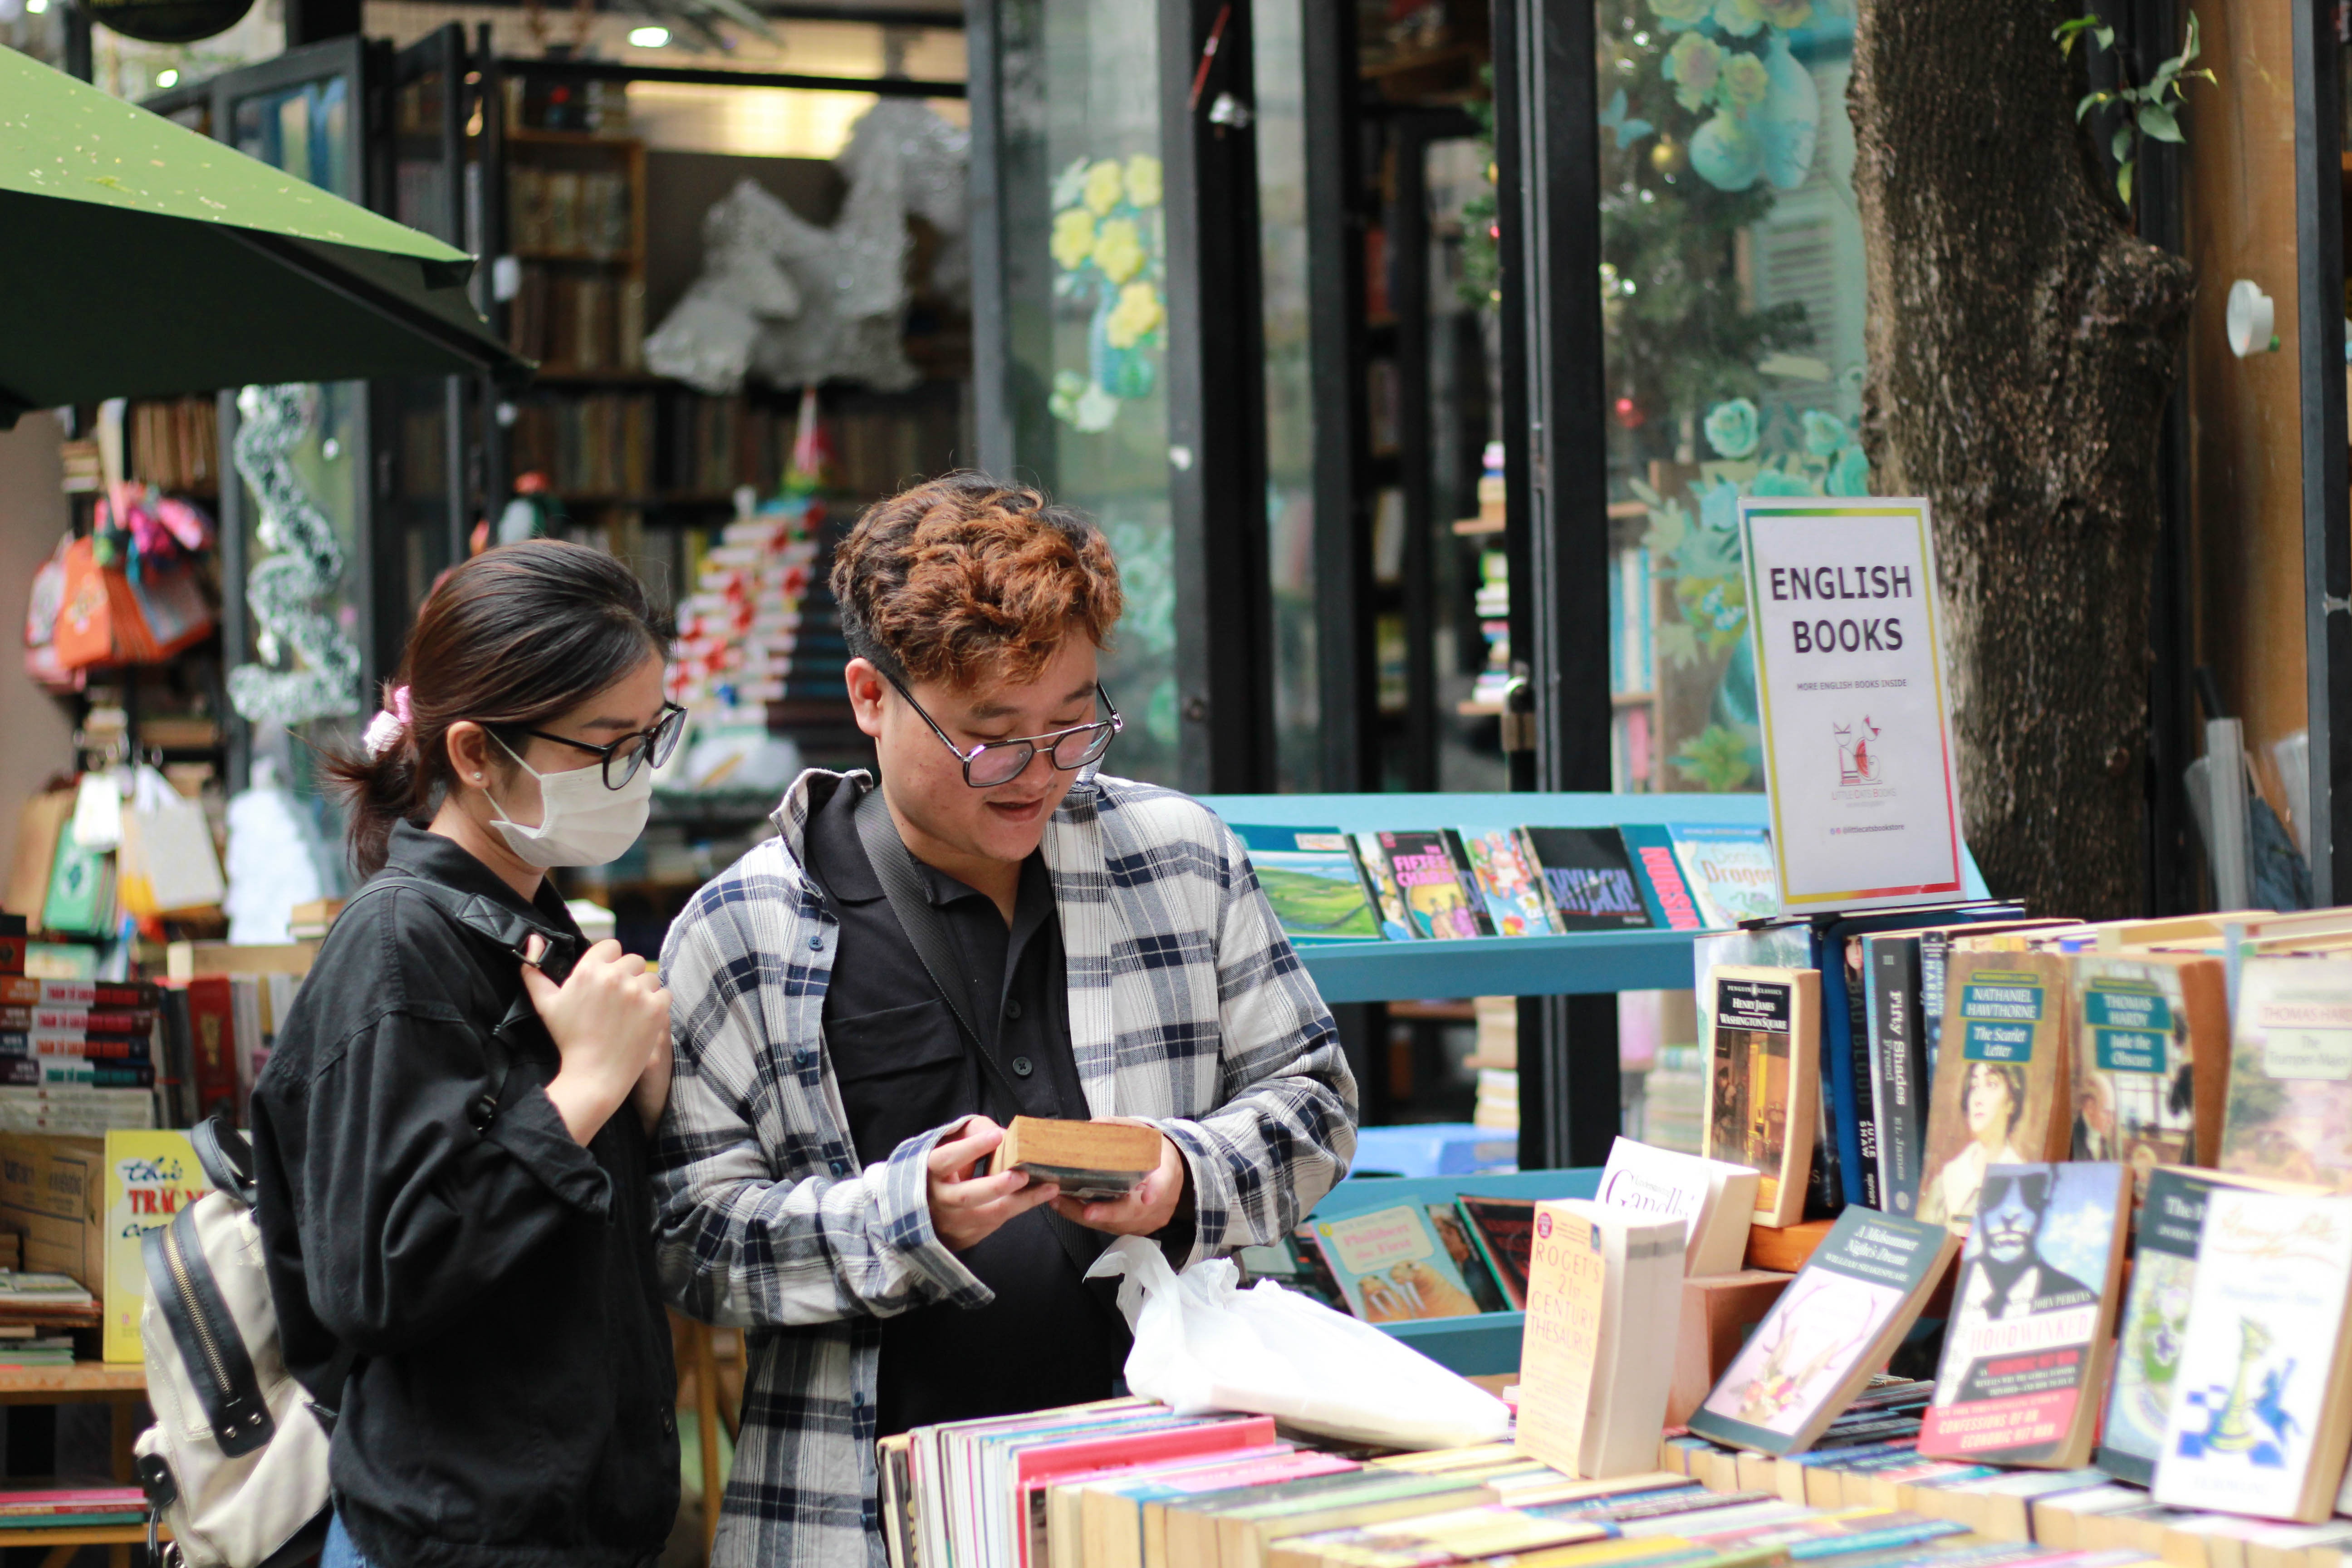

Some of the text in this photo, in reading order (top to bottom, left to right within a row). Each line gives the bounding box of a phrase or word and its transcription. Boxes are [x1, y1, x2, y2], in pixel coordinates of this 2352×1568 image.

[1770, 566, 1912, 601] ENGLISH
[1793, 618, 1903, 653] BOOKS
[1797, 679, 1907, 691] MORE ENGLISH BOOKS INSIDE
[1873, 788, 1897, 798] BOOKS
[1926, 960, 1937, 1016] HARRIS
[1972, 988, 2033, 1003] NATHANIEL
[1732, 998, 1776, 1012] HENRY JAMES
[1966, 1002, 2037, 1019] HAWTHORNE
[2103, 994, 2153, 1012] THOMAS
[2264, 1007, 2317, 1021] THOMAS
[1720, 1013, 1787, 1030] WASHINGTON SQUARE
[2110, 1010, 2149, 1028] HARDY
[1847, 979, 1871, 1106] BAD BLOOD
[1974, 1026, 2027, 1043] The Scarlet
[2111, 1033, 2152, 1050] Jude the
[1883, 1039, 1894, 1081] Freed
[1889, 990, 1908, 1106] Fifty Shades
[1984, 1043, 2012, 1058] Letter
[2111, 1051, 2153, 1067] Obscure
[1859, 1120, 1870, 1157] SHAW
[1866, 1120, 1876, 1157] JULIE
[1896, 1137, 1905, 1180] James
[2165, 1196, 2193, 1219] The
[1854, 1225, 1866, 1237] A
[1865, 1227, 1919, 1251] Midsummer
[1536, 1241, 1600, 1284] ROGET'S
[1844, 1239, 1908, 1266] Night's Dream
[1825, 1252, 1909, 1282] WILLIAM SHAKESPEARE
[1532, 1290, 1596, 1331] CENTURY
[2033, 1291, 2091, 1310] JOHN PERKINS
[1531, 1315, 1593, 1358] THESAURUS
[1970, 1313, 2087, 1352] HOODWINKED
[1938, 1409, 2039, 1434] CONFESSIONS OF AN
[1960, 1423, 2056, 1449] ECONOMIC HIT MAN
